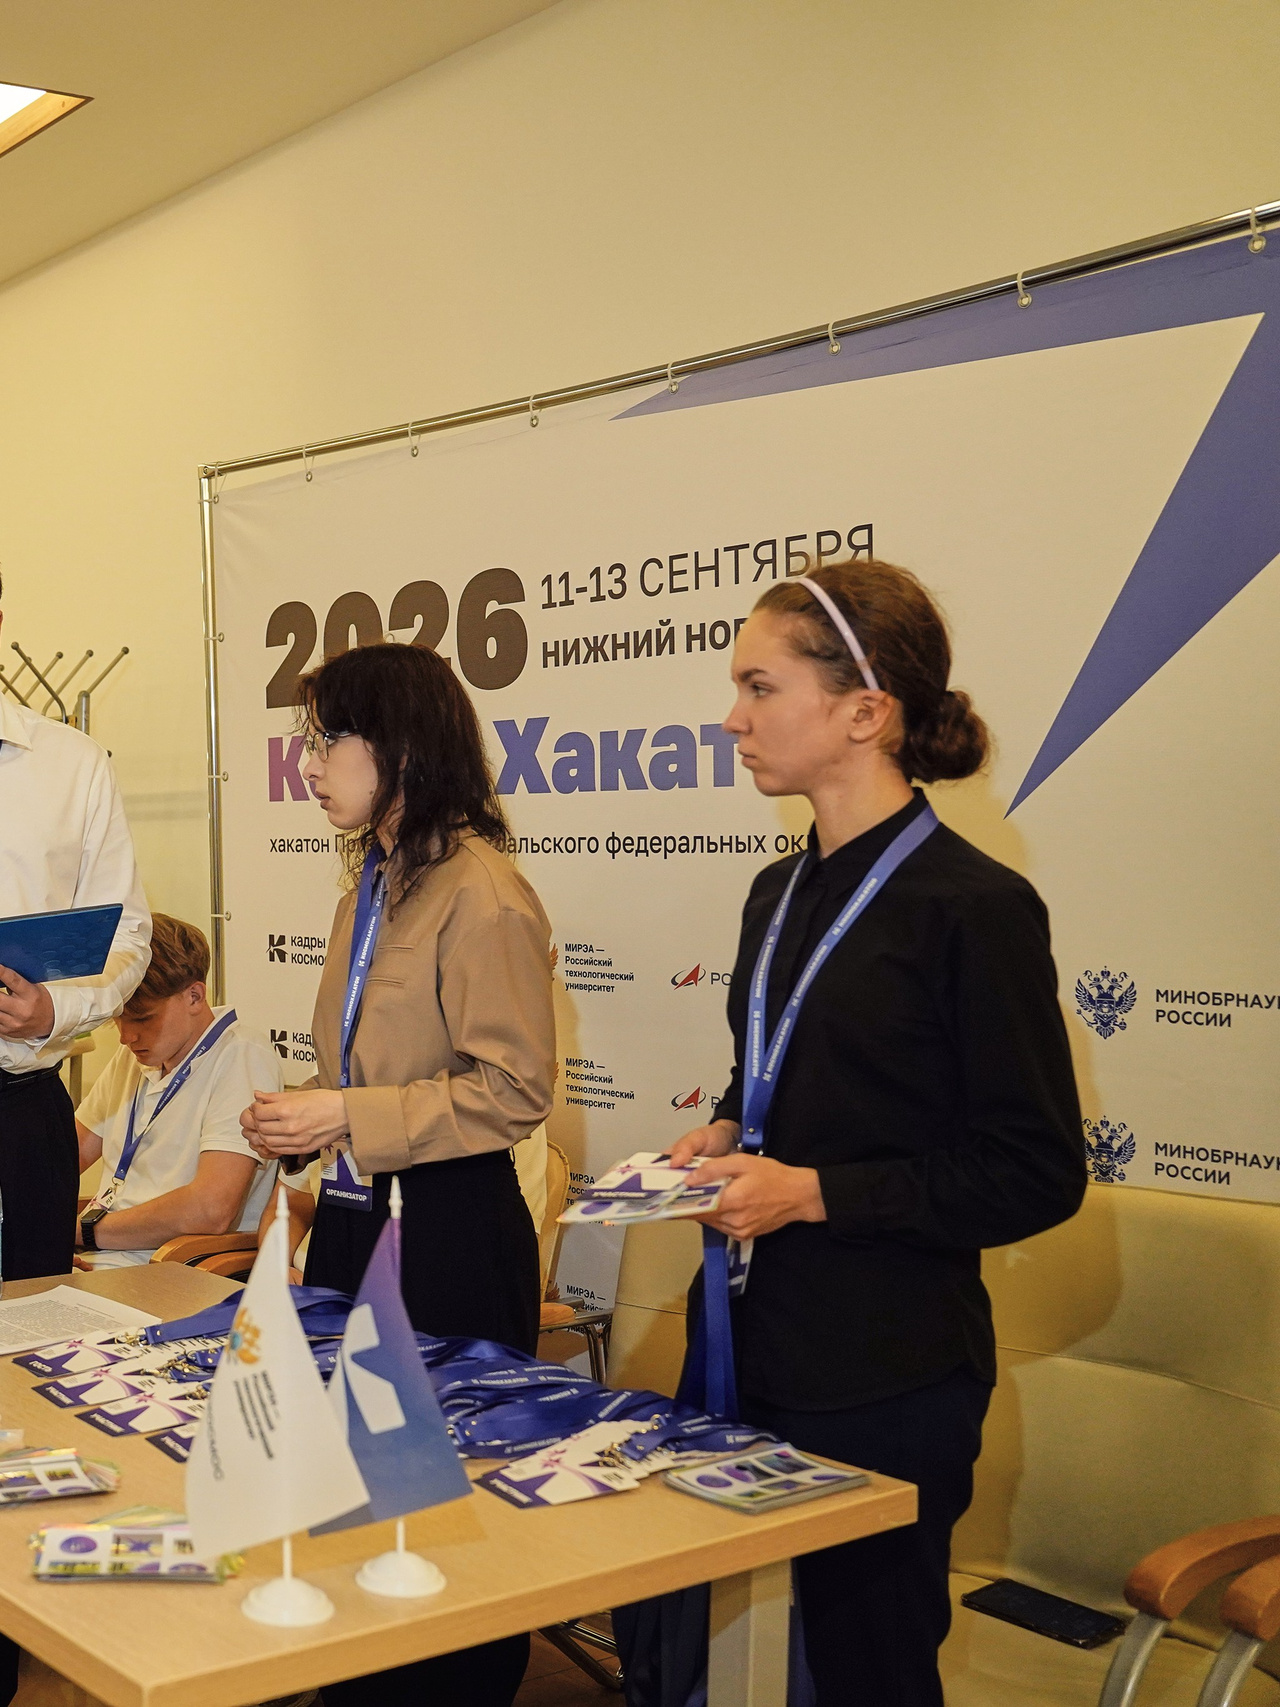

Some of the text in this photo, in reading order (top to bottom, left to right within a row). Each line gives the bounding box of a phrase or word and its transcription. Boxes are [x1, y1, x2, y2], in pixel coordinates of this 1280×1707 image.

[541, 523, 875, 610] 11-13 СЕНТЯБРЯ
[265, 567, 529, 710] 2026
[542, 618, 676, 669] НИЖНИЙ
[269, 837, 331, 854] хакатон
[605, 831, 768, 860] федеральных
[290, 935, 327, 952] кадры
[564, 943, 595, 954] МИРЭА
[291, 953, 327, 966] космо
[564, 956, 613, 967] Российский
[564, 969, 635, 982] технологический
[564, 981, 616, 993] университет
[1155, 1009, 1232, 1028] РОССИИ
[292, 1031, 315, 1049] кад
[565, 1057, 595, 1069] МИРЭА
[565, 1070, 614, 1084] Российский
[565, 1083, 635, 1100] технологический
[565, 1096, 616, 1110] университет
[1154, 1162, 1231, 1186] РОССИИ
[325, 1188, 368, 1202] ОРГАНИЗАТОР
[566, 1284, 596, 1300] МИРЭА
